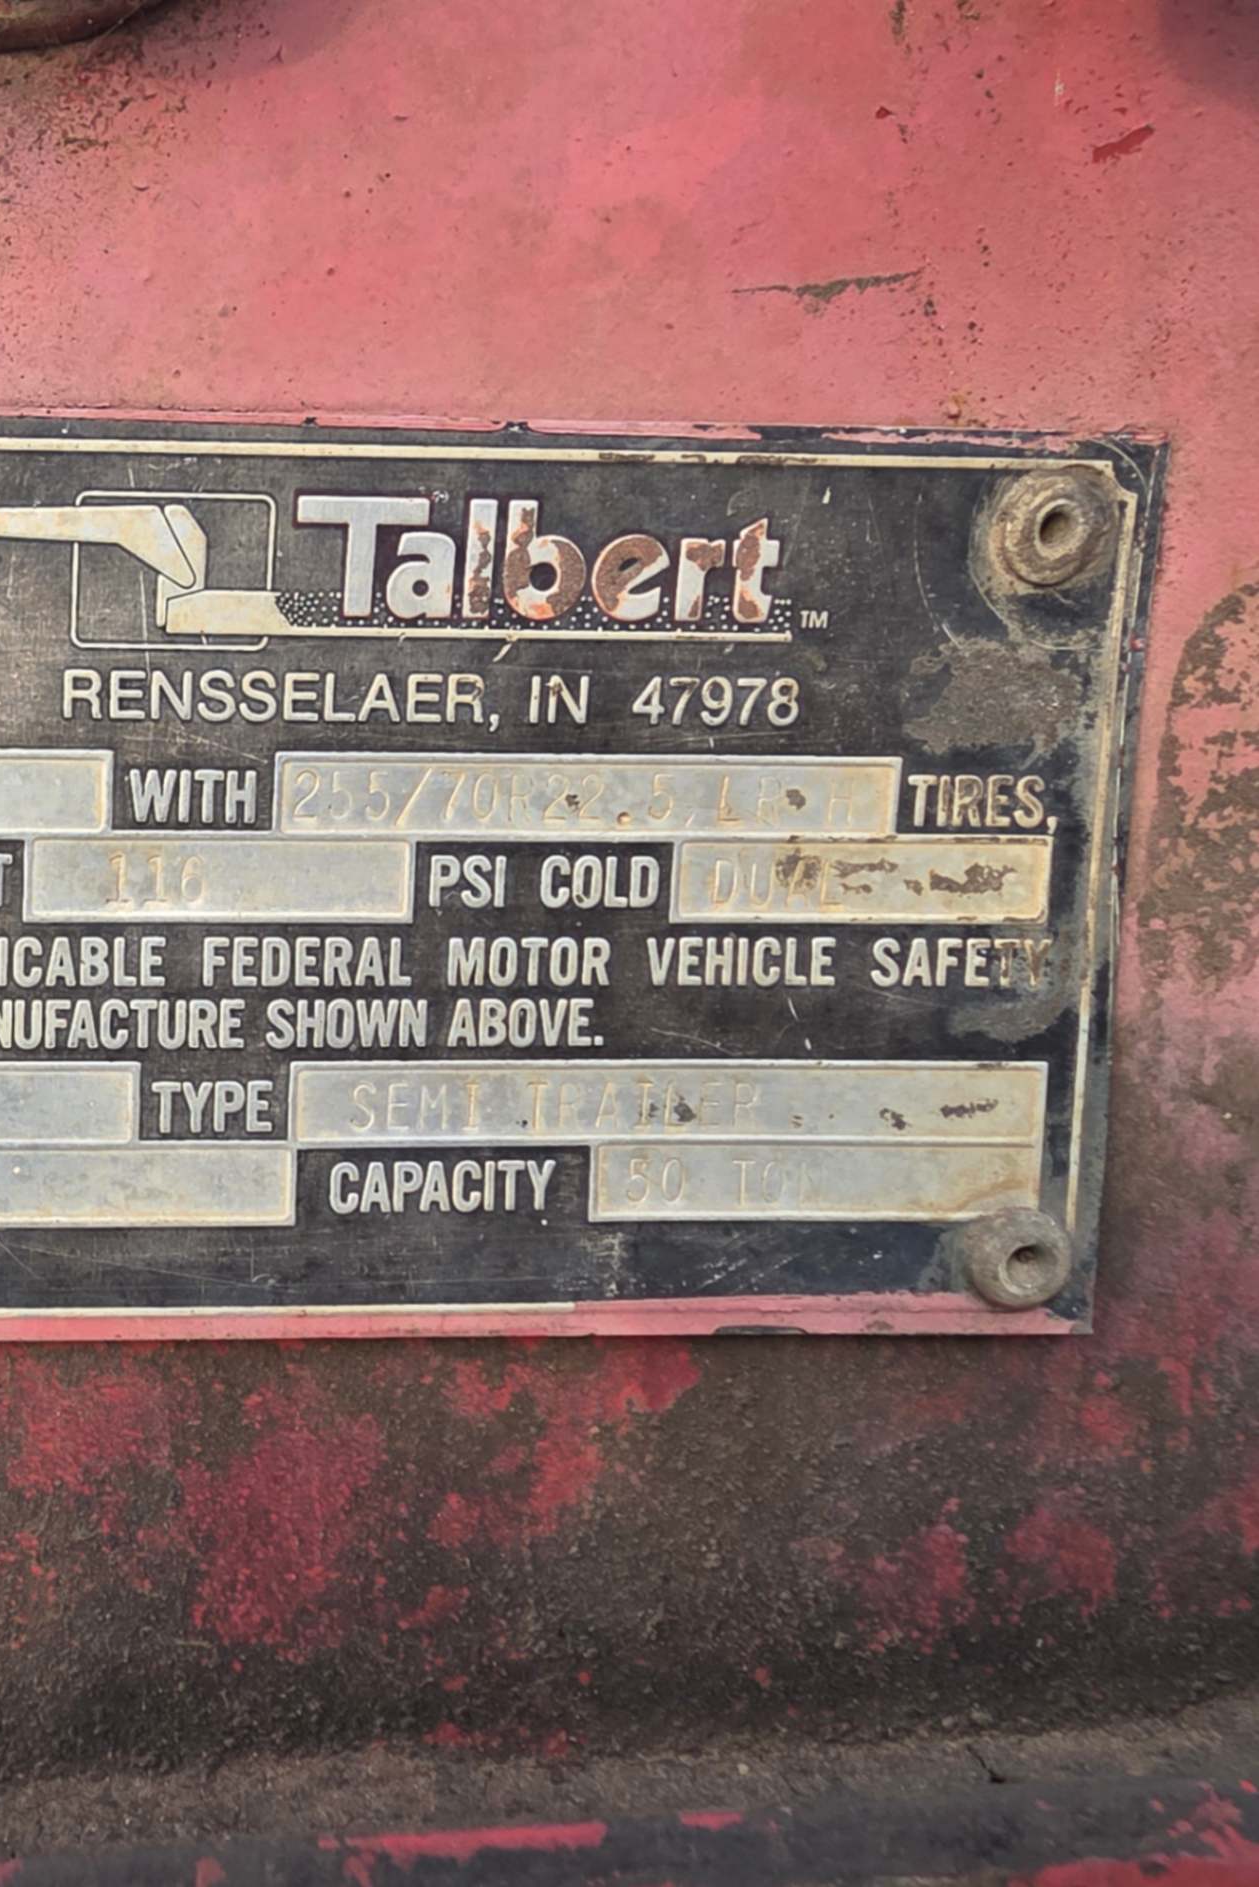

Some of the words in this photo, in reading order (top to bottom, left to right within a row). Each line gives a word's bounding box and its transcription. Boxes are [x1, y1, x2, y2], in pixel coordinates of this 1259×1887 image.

[295, 488, 780, 624] Talbert
[63, 668, 500, 732] RENSSELAER,
[528, 674, 590, 725] IN
[632, 675, 800, 728] 47978
[130, 768, 258, 825] WITH
[907, 773, 1058, 834] TIRES,
[428, 853, 508, 909] PSI
[540, 854, 660, 909] COLD
[202, 936, 412, 988] FEDERAL
[447, 936, 611, 988] MOTOR
[646, 936, 837, 988] VEHICLE
[870, 936, 1054, 988] SAFETY
[265, 998, 428, 1050] SHOWN
[447, 998, 605, 1048] ABOVE.
[151, 1080, 274, 1134] TYPE
[350, 1081, 481, 1132] SEMI
[330, 1160, 557, 1214] CAPACITY
[626, 1157, 686, 1205] 50
